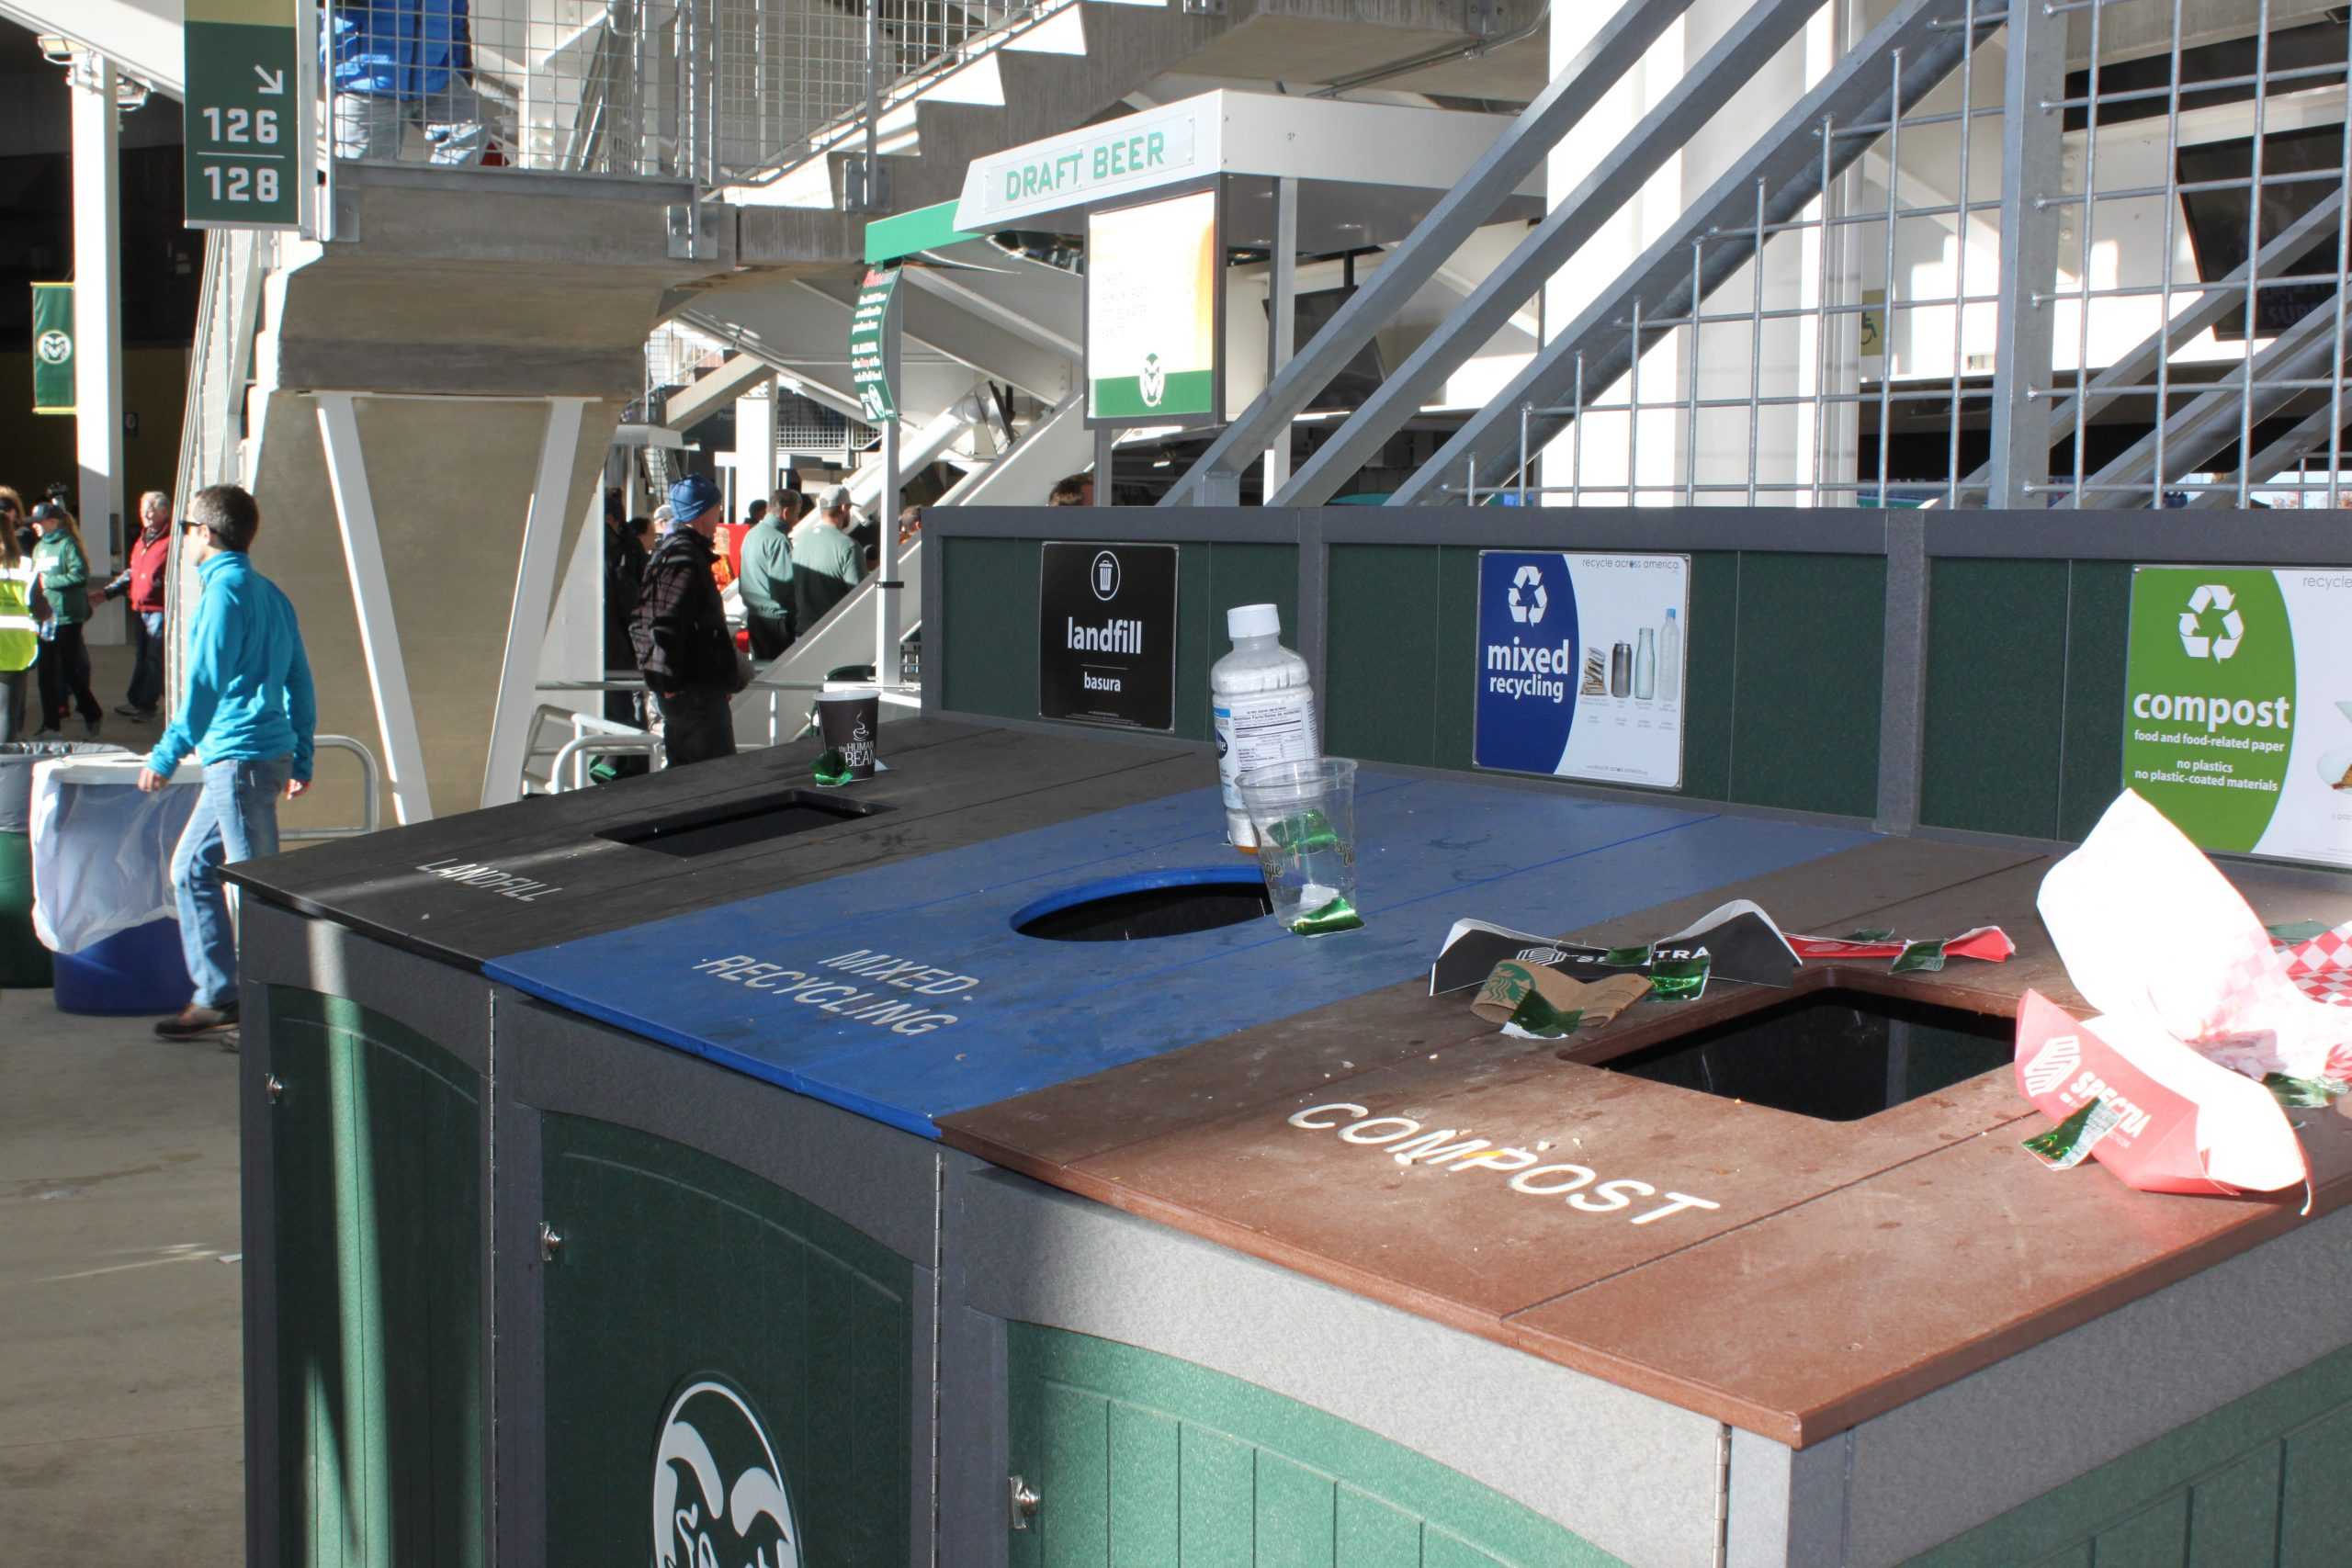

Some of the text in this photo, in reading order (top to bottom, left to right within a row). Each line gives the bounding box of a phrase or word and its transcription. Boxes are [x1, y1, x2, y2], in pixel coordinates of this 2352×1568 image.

[203, 107, 278, 143] 126
[204, 166, 279, 202] 128
[1006, 132, 1164, 201] DRAFT BEER
[1581, 557, 1613, 569] recycle
[2302, 575, 2352, 592] recycle
[1067, 616, 1142, 654] landfill
[1487, 636, 1569, 675] mixed
[1083, 671, 1121, 692] basura
[1489, 674, 1564, 704] recycling
[2133, 693, 2290, 732] compost
[845, 749, 875, 767] BEAN
[2134, 729, 2285, 753] food and food-related paper
[2134, 769, 2278, 792] no plastic-coated materials
[2177, 759, 2233, 773] no plastics
[818, 949, 980, 995] MIXED
[692, 954, 958, 1035] RECYCLING
[1287, 1102, 1721, 1224] COMPOST
